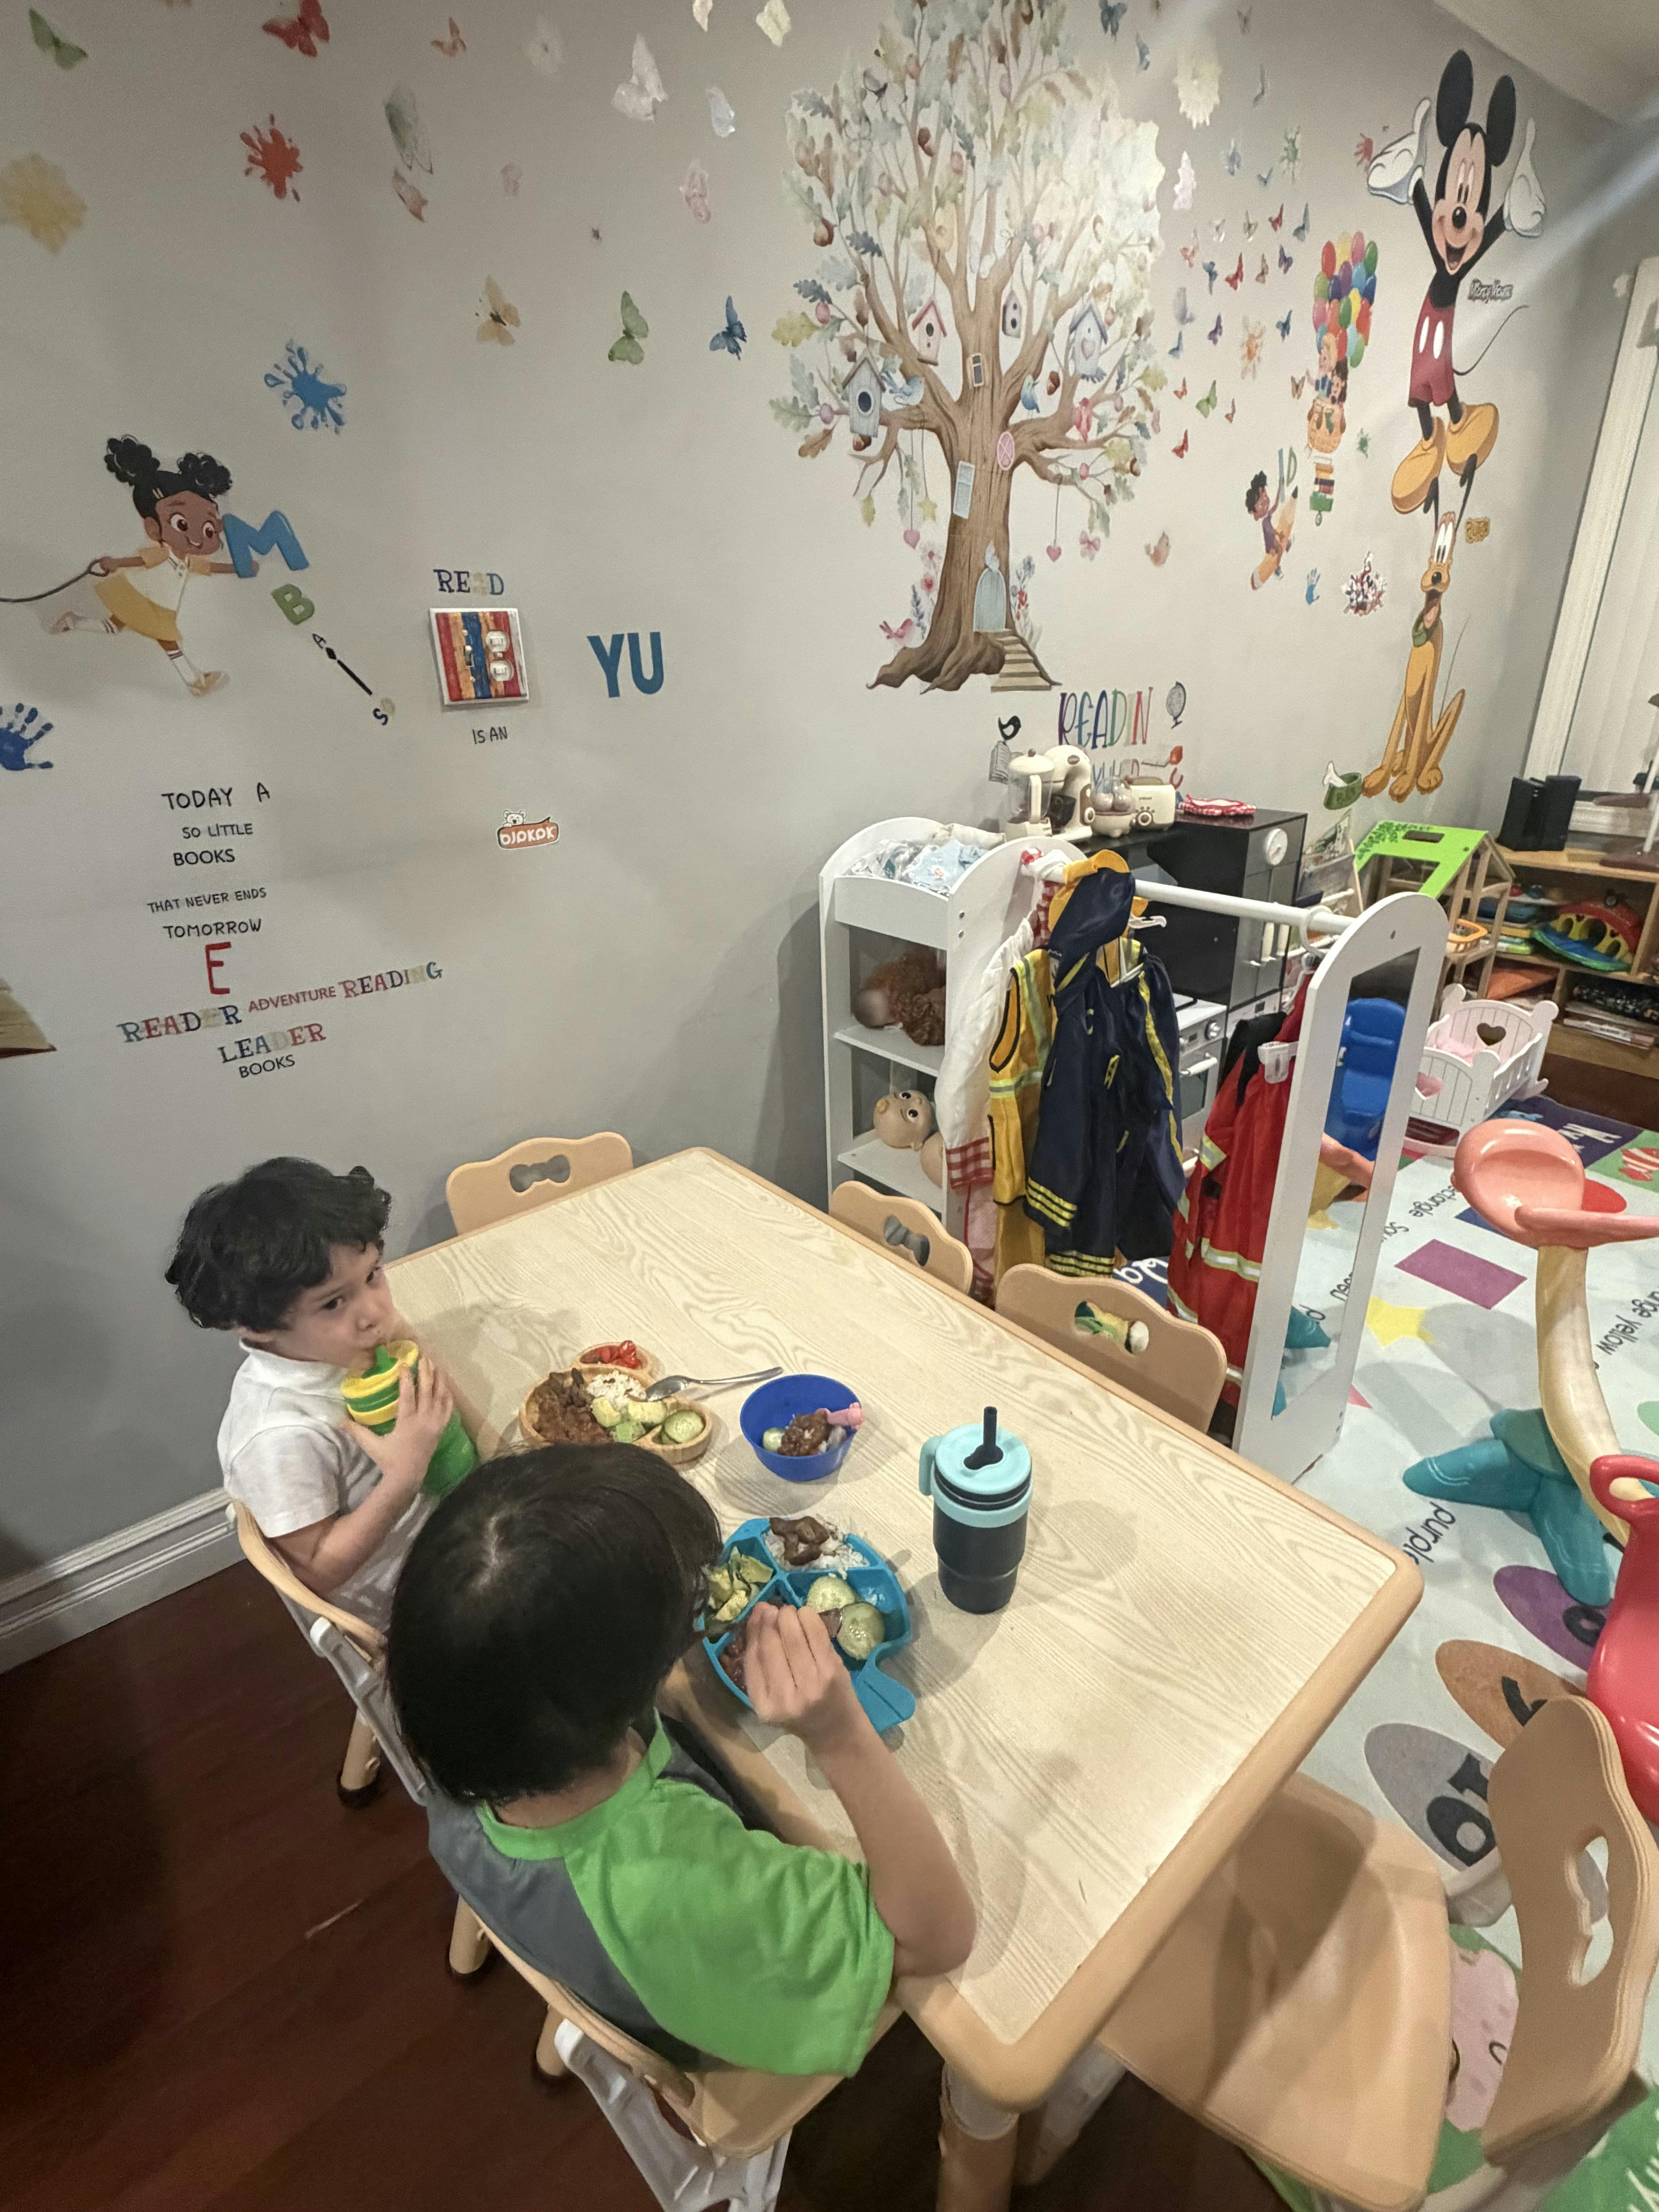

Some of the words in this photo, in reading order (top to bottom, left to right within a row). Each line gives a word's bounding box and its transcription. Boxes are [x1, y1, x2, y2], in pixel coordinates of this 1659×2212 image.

[222, 510, 309, 579] M
[271, 584, 315, 625] B
[586, 632, 664, 698] YU
[472, 729, 486, 744] IS
[489, 726, 508, 742] AN
[161, 787, 233, 810] TODAY
[257, 782, 271, 802] A
[182, 825, 201, 839] SO
[208, 823, 253, 837] LITTLE
[173, 848, 235, 866] BOOKS
[147, 898, 180, 914] THAT
[186, 892, 229, 908] NEVER
[235, 887, 267, 902] ENDS
[163, 918, 262, 939] TOMORROW
[204, 941, 232, 995] E
[248, 986, 337, 1013] ADVENTURE
[238, 1054, 296, 1078] BOOKS
[1596, 1314, 1643, 1355] yellow
